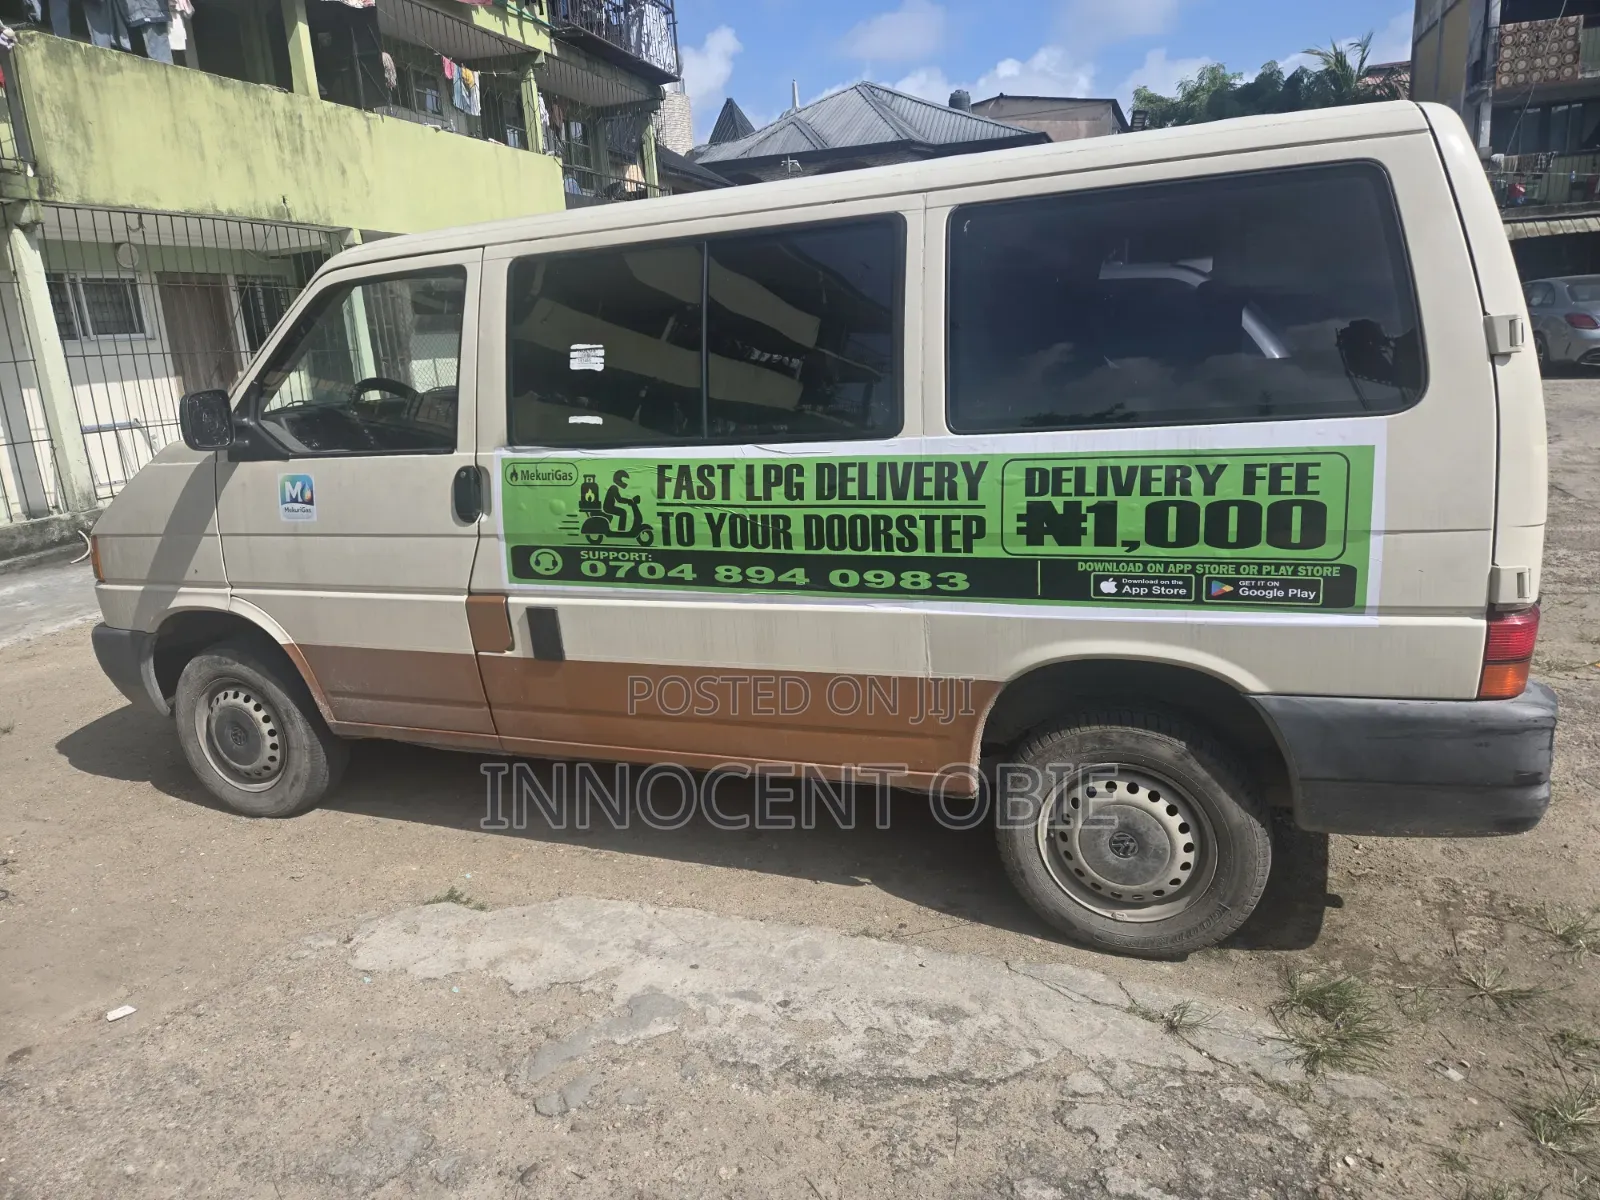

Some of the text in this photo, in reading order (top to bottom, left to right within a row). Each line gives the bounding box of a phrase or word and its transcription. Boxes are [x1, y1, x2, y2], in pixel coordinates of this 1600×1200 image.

[520, 467, 573, 481] MekuriGas
[656, 461, 989, 502] FAST LPG DELIVERY
[1025, 462, 1322, 498] DELIVERY FEE
[656, 511, 987, 554] TO YOUR DOORSTEP
[580, 550, 652, 562] SUPPORT:
[580, 561, 970, 592] 0704 894 0983
[1077, 561, 1341, 577] DOWNLOAD ON APP STORE OR PLAY STORE
[1121, 585, 1187, 596] App Store
[1238, 587, 1317, 600] Google Play
